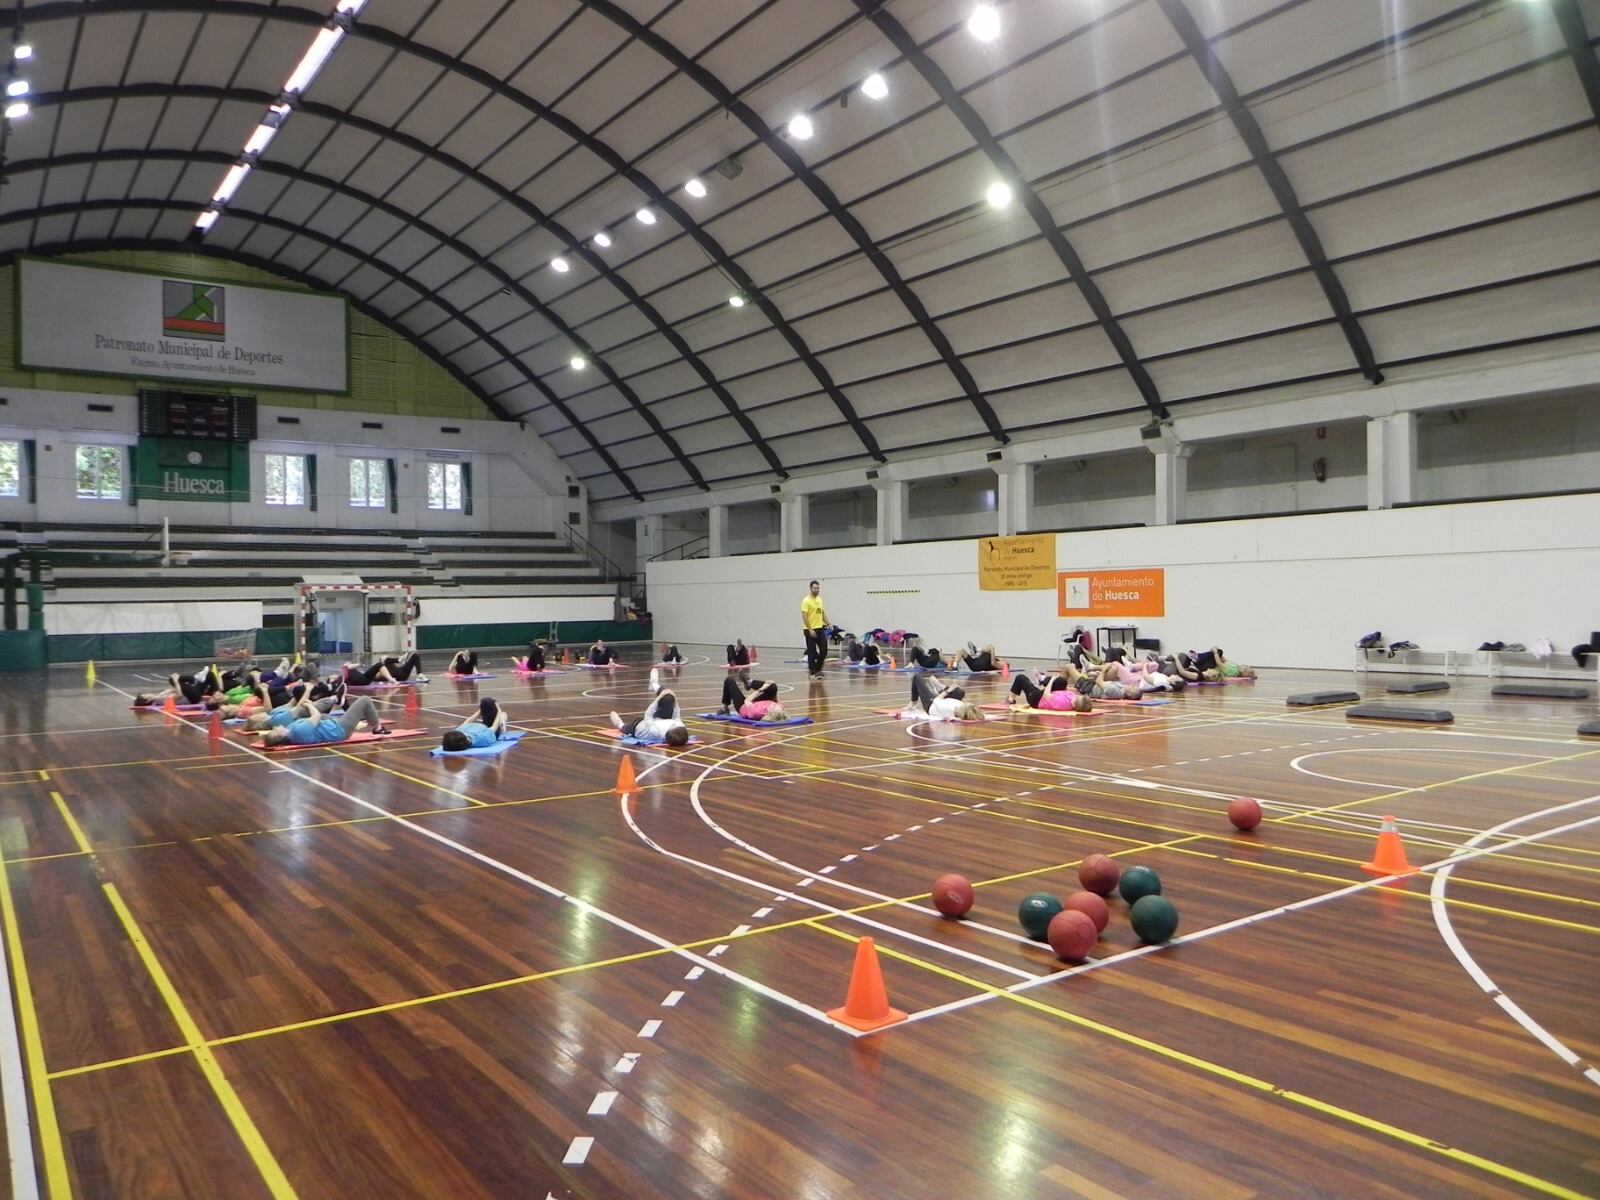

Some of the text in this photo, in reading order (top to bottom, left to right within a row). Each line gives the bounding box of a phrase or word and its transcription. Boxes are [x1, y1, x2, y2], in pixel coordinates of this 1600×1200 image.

[95, 334, 283, 365] Patronato Municipal de Deportes
[228, 365, 255, 376] Huesca
[164, 471, 225, 494] Huesca
[1092, 576, 1154, 590] Ayuntamiento
[1092, 589, 1139, 600] de Huesca
